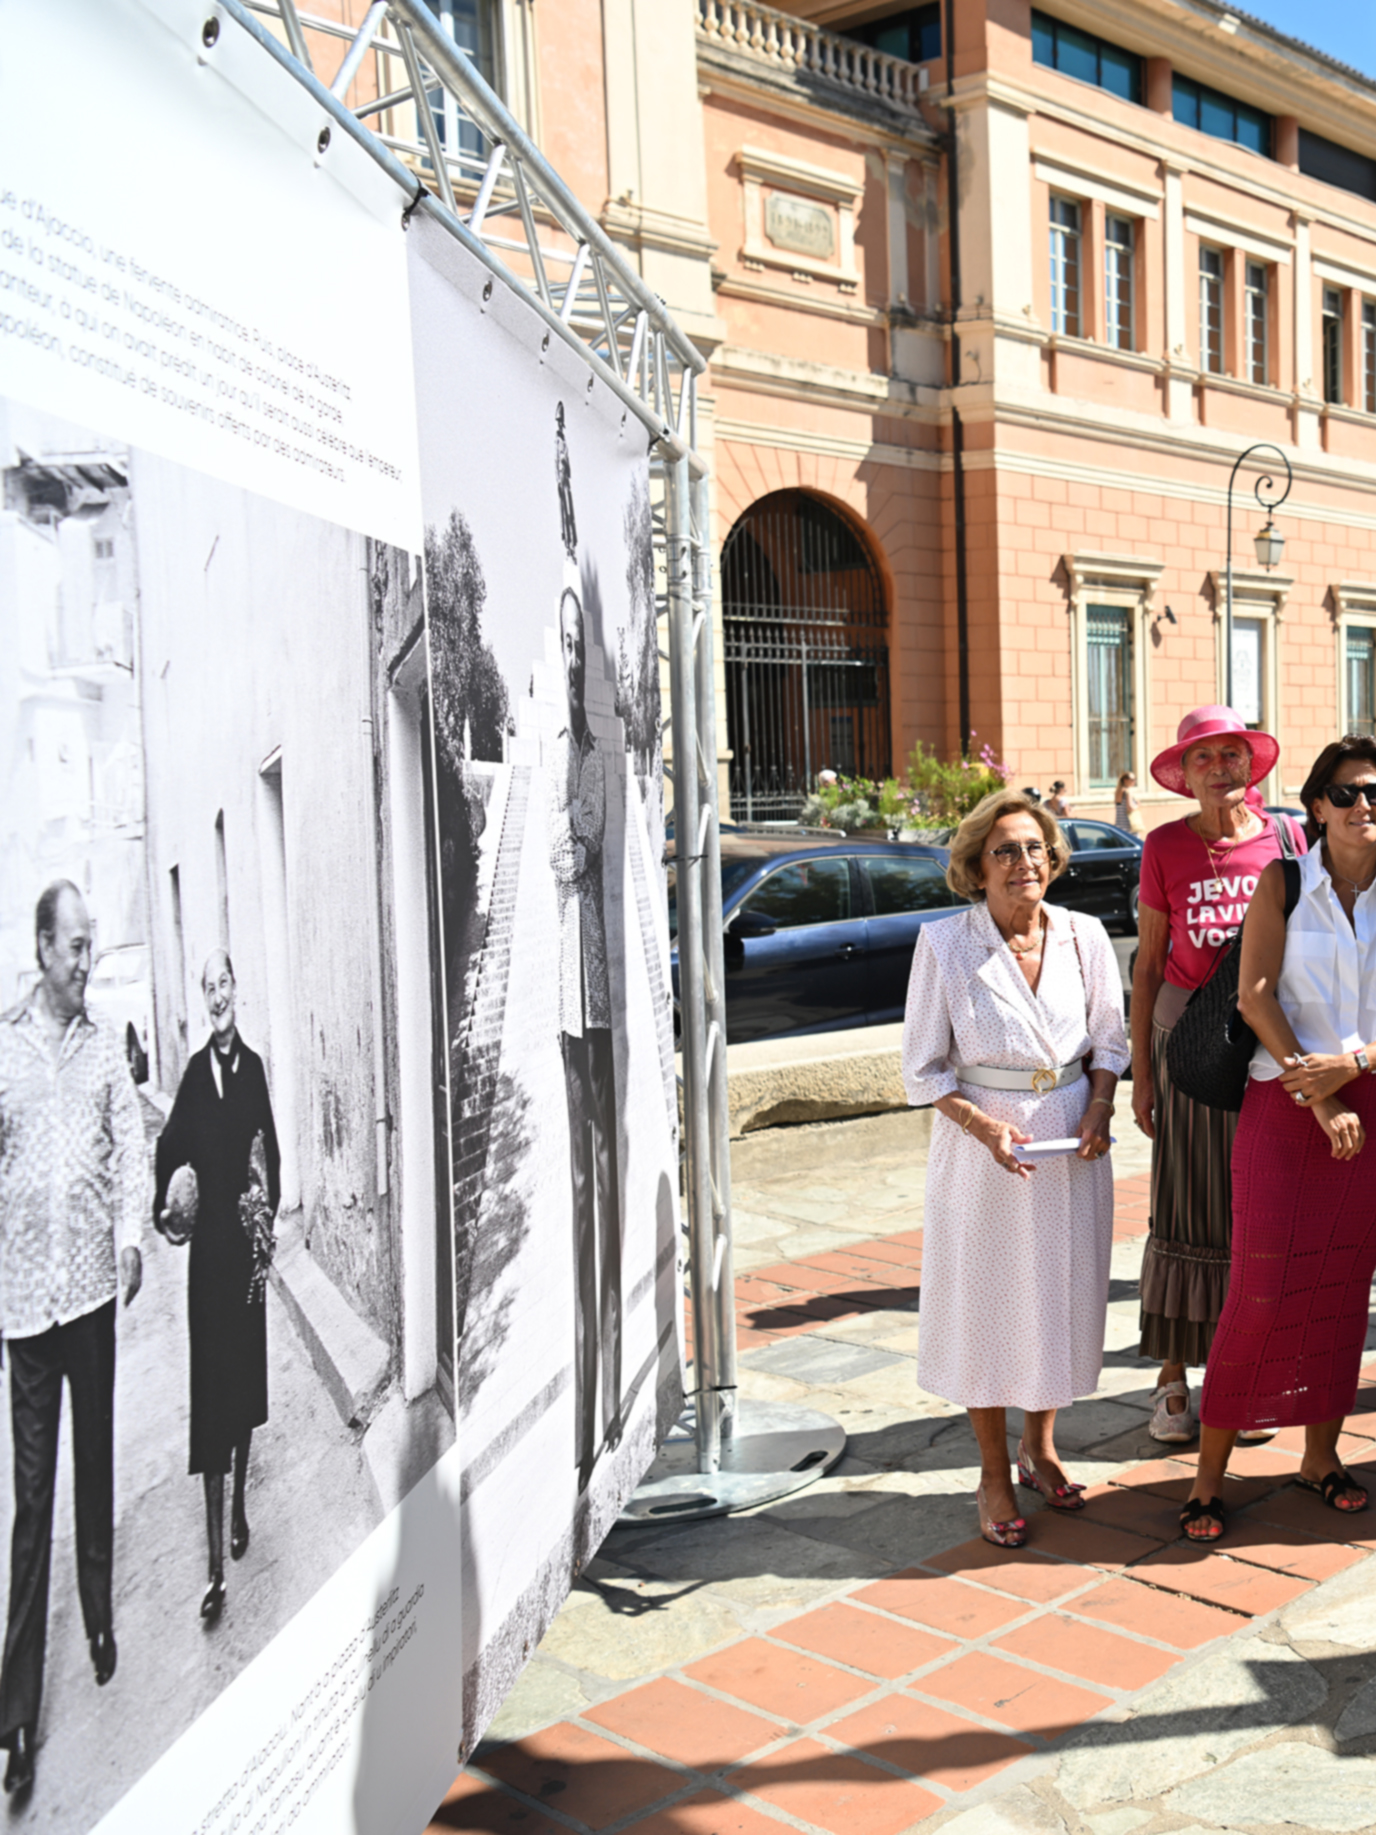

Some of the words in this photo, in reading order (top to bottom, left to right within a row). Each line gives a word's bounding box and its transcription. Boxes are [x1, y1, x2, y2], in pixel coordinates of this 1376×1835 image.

[21, 199, 96, 260] d'Ajaccio,
[100, 245, 127, 273] une
[129, 256, 182, 304] fervente
[1, 227, 23, 255] de
[28, 236, 43, 265] la
[48, 254, 97, 294] statue
[101, 280, 120, 306] de
[124, 289, 187, 338] Napoléon
[190, 330, 205, 348] en
[239, 355, 253, 377] de
[292, 383, 305, 404] de
[75, 306, 99, 334] qui
[102, 321, 121, 343] on
[123, 331, 158, 363] avait
[200, 370, 214, 389] un
[215, 374, 237, 399] jour
[263, 400, 289, 427] serait
[140, 374, 157, 398] de
